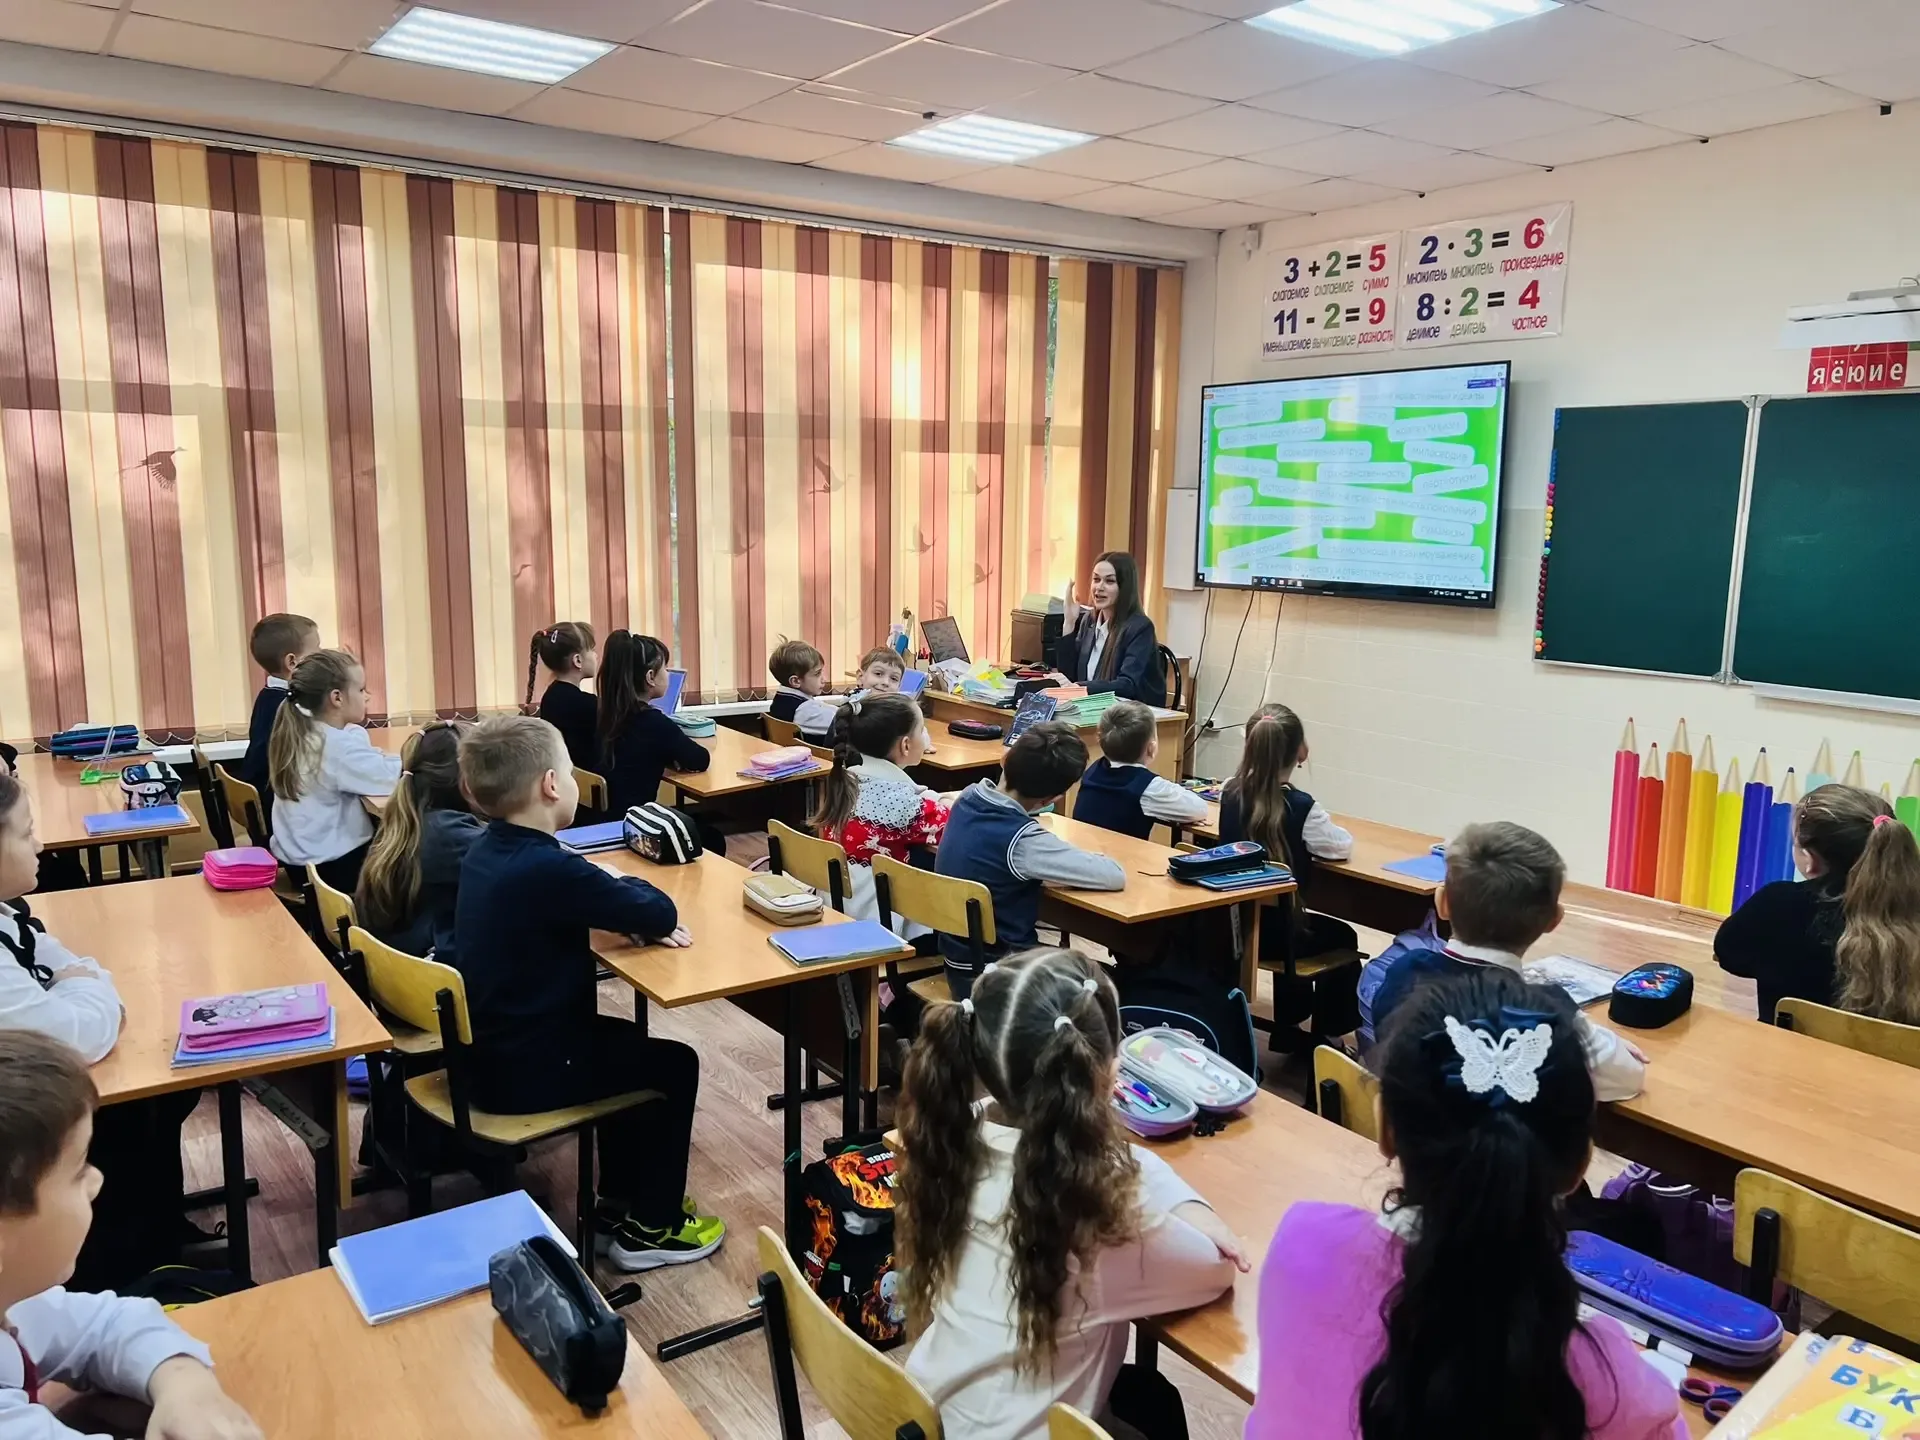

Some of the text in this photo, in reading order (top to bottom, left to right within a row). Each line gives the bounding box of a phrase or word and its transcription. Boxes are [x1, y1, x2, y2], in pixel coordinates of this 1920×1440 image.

[1419, 235, 1438, 265] 2
[1464, 228, 1483, 257] 3
[1524, 218, 1545, 249] 6
[1284, 257, 1300, 284] 3
[1406, 251, 1564, 285] множитель множитель произведение
[1272, 276, 1389, 302] слагаемое слагаемое сумма
[1416, 292, 1435, 321] 8
[1459, 287, 1479, 317] 2
[1518, 279, 1541, 310] 4
[1273, 307, 1299, 336] 11
[1406, 314, 1548, 342] делимое делитель частное
[1357, 328, 1394, 346] разность
